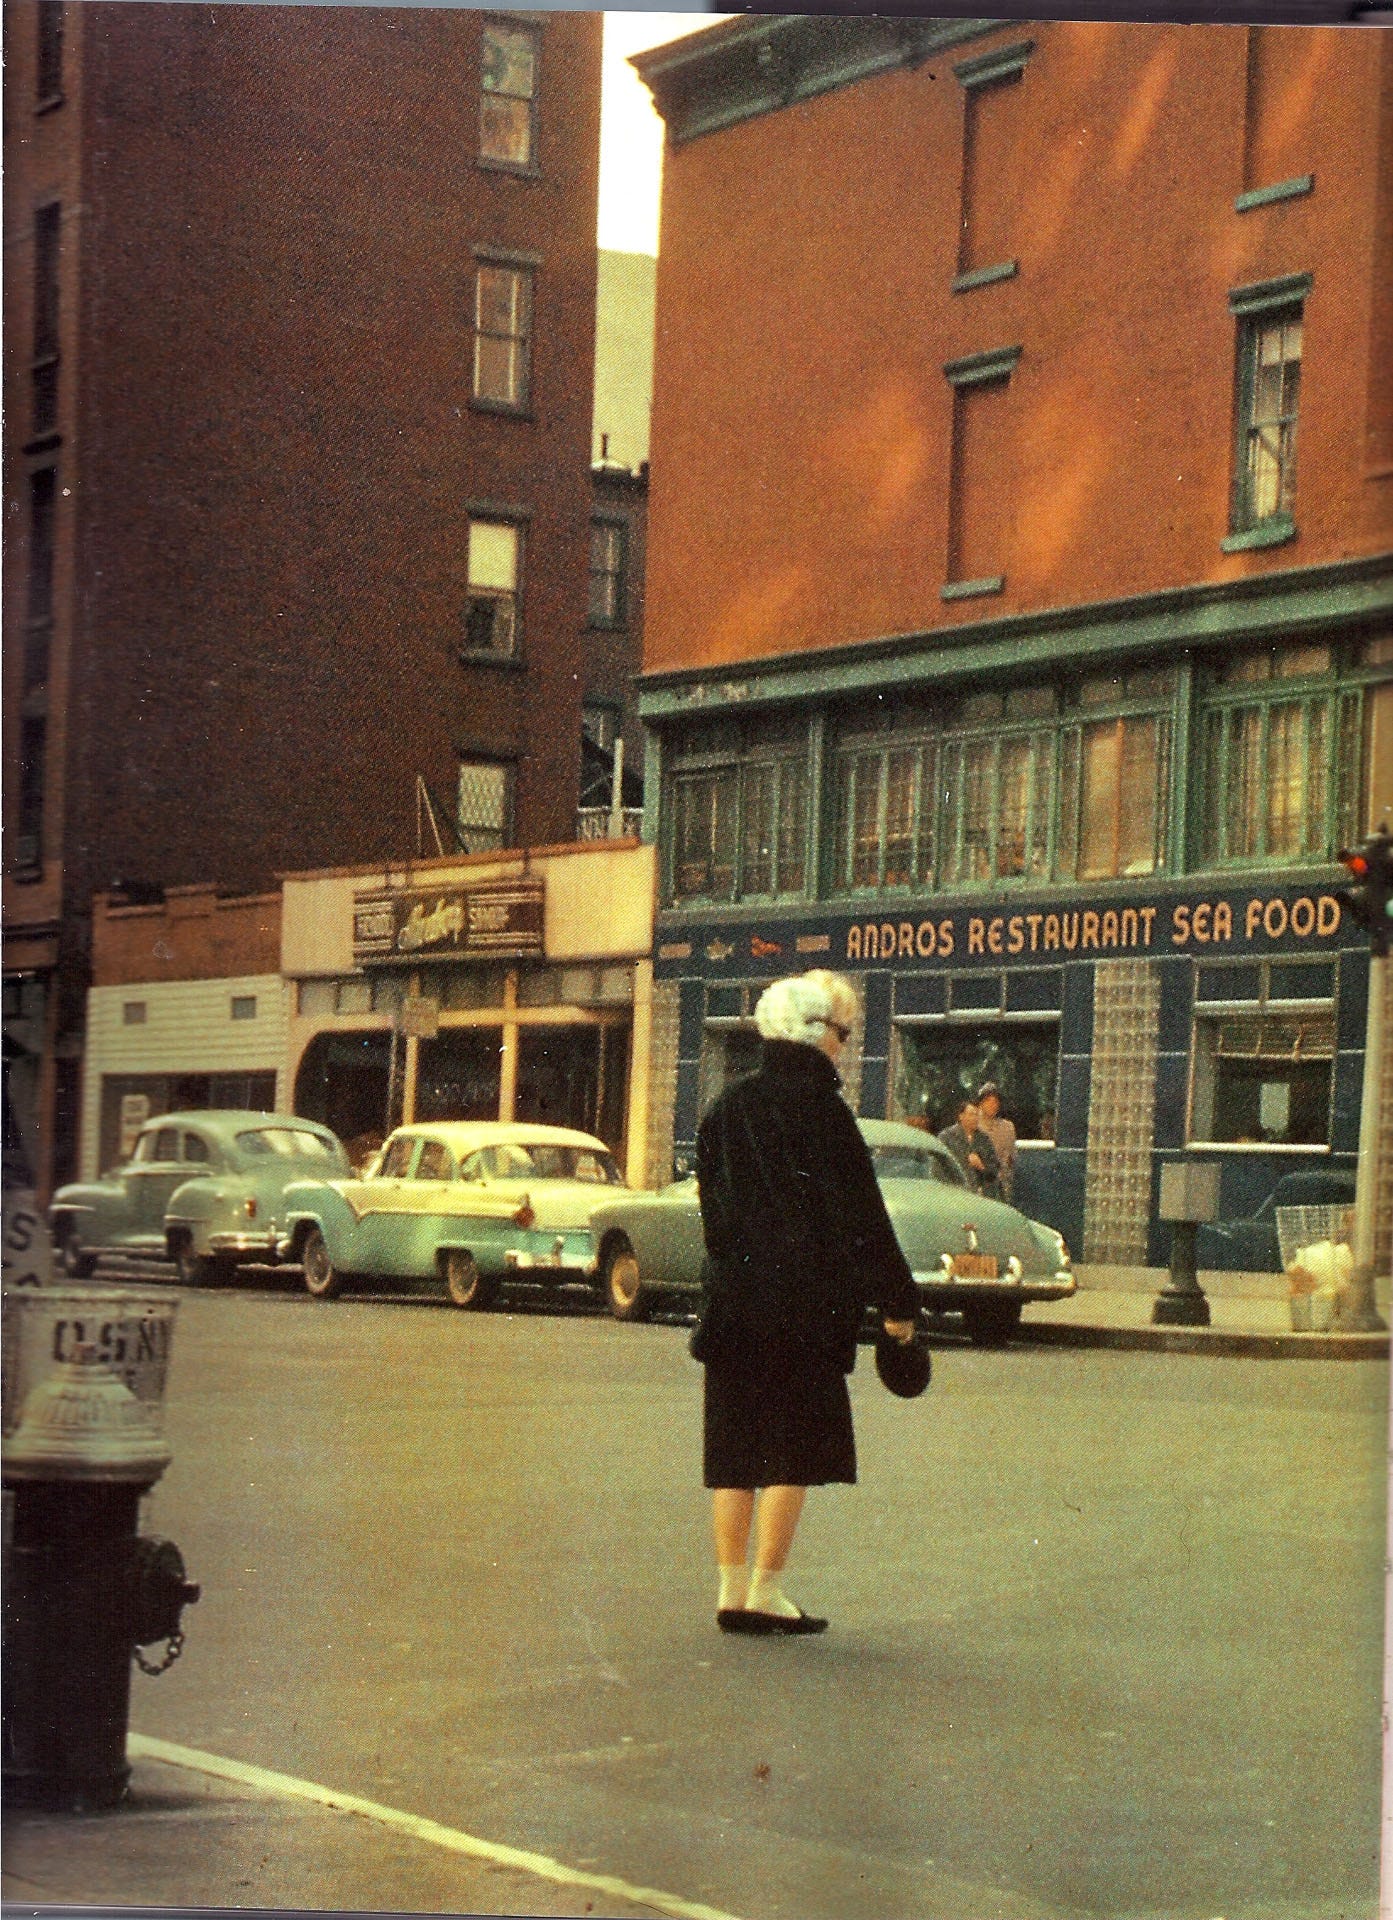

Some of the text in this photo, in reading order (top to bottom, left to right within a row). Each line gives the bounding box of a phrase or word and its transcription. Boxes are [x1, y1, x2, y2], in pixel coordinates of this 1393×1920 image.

[847, 895, 1342, 960] ANDROS RESTAURANT SEA FOOD
